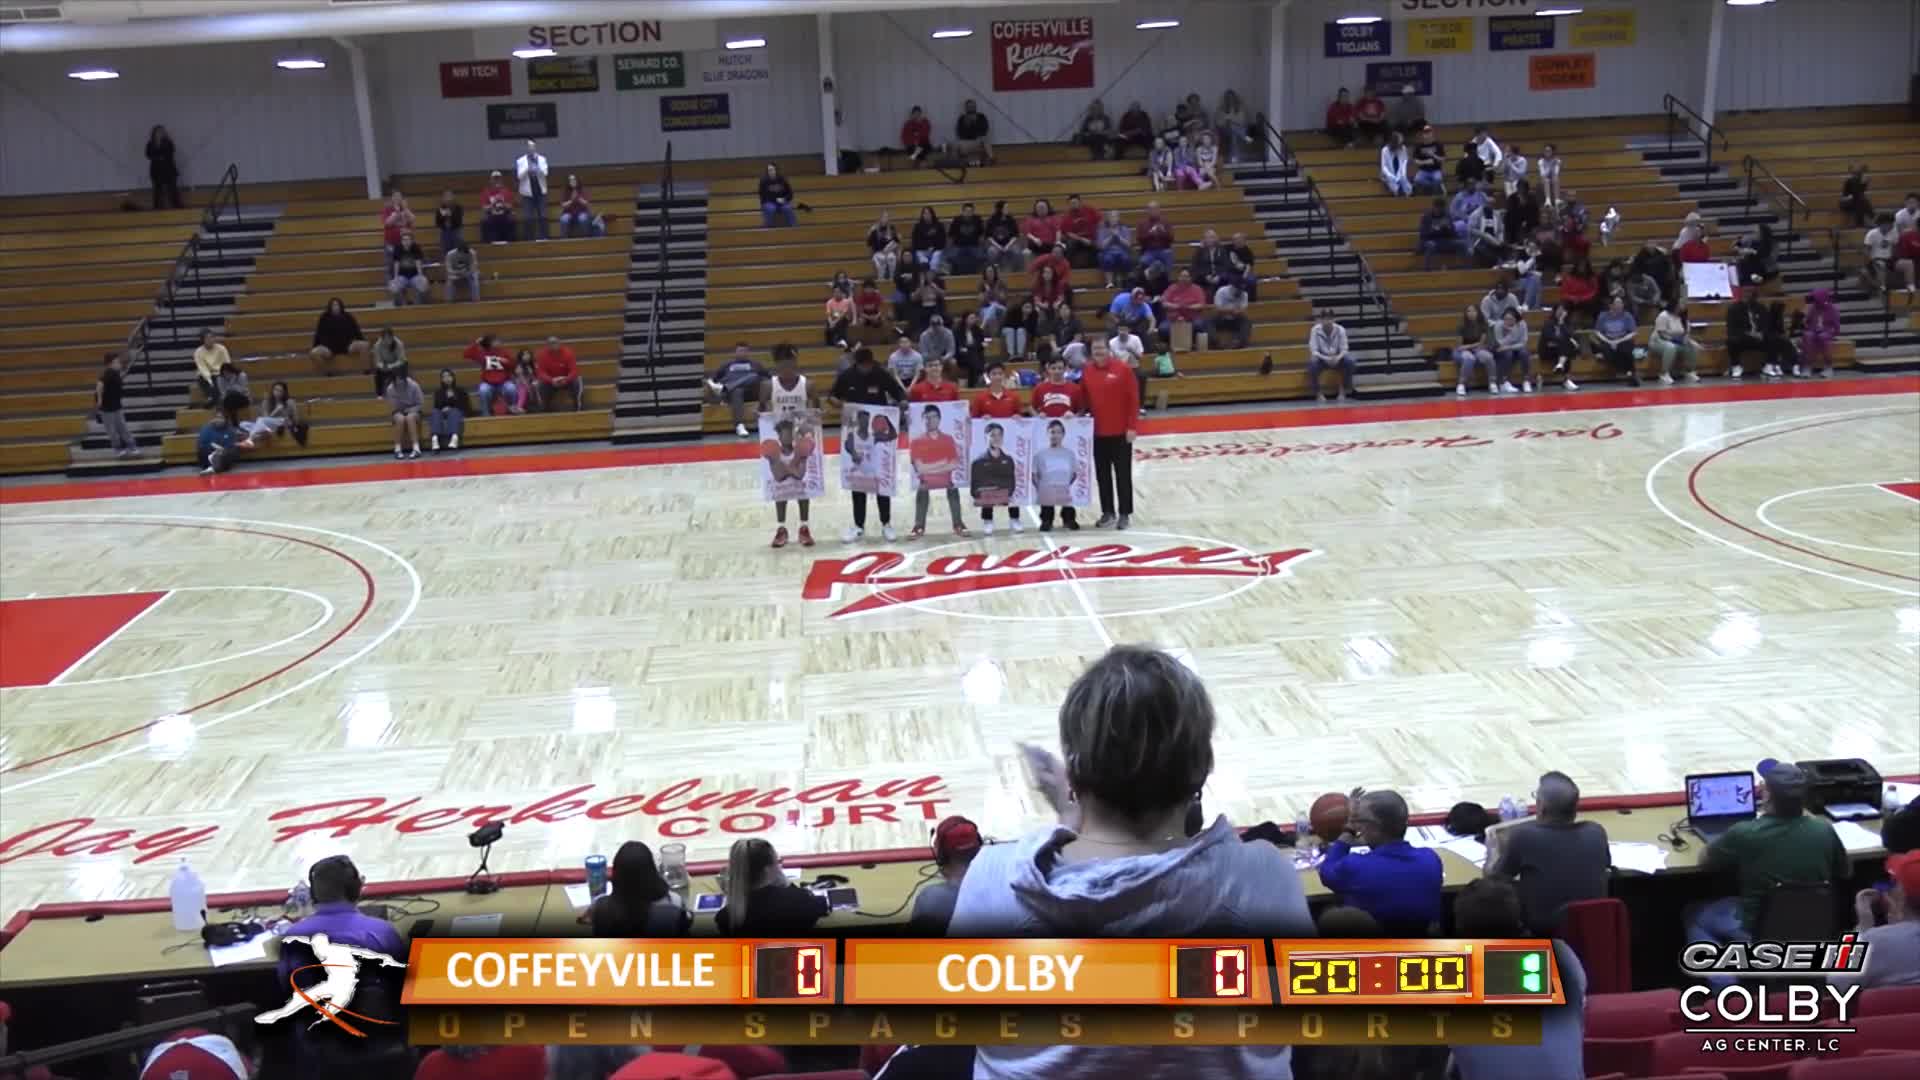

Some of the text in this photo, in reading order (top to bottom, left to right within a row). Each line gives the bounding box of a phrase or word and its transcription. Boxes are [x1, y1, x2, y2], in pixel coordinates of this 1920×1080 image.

[529, 20, 662, 48] SECTION
[993, 19, 1089, 39] COFFEYVILLE
[1341, 26, 1375, 38] COLBY
[1336, 41, 1381, 54] TROJANS
[718, 54, 752, 65] HUTCH
[1006, 42, 1079, 76] Ravens
[452, 64, 499, 78] NW TECH
[632, 73, 669, 85] SAINTS
[802, 543, 1320, 616] Ravens
[0, 775, 947, 864] Jay Herkelman
[658, 799, 950, 838] COURT
